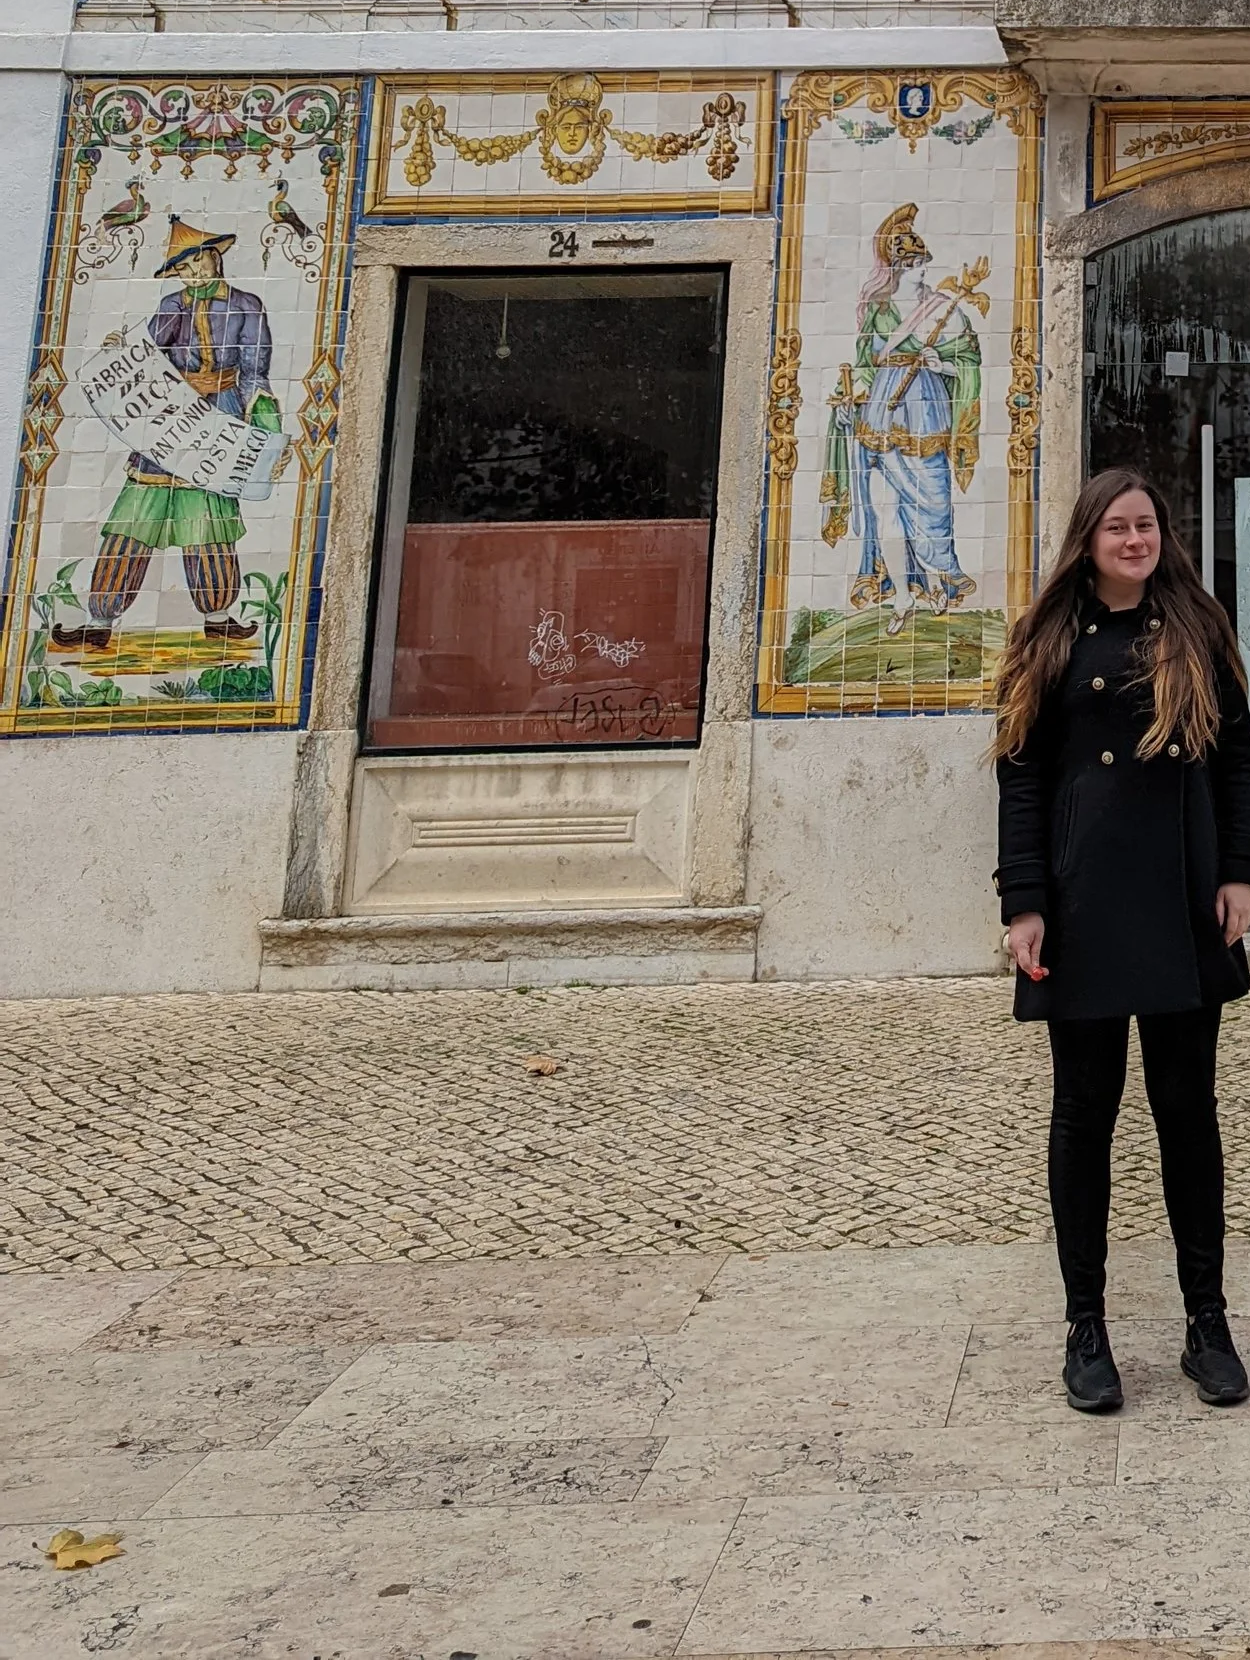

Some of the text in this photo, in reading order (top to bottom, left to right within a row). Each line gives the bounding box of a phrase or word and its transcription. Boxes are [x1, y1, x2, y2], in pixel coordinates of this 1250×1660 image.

[548, 230, 579, 258] 24
[82, 337, 155, 404] FABRICA
[109, 370, 183, 433] LOIÇA
[119, 368, 146, 399] DE
[150, 403, 181, 427] DE
[150, 396, 213, 465] ANTONIO
[191, 419, 246, 488] COSTA
